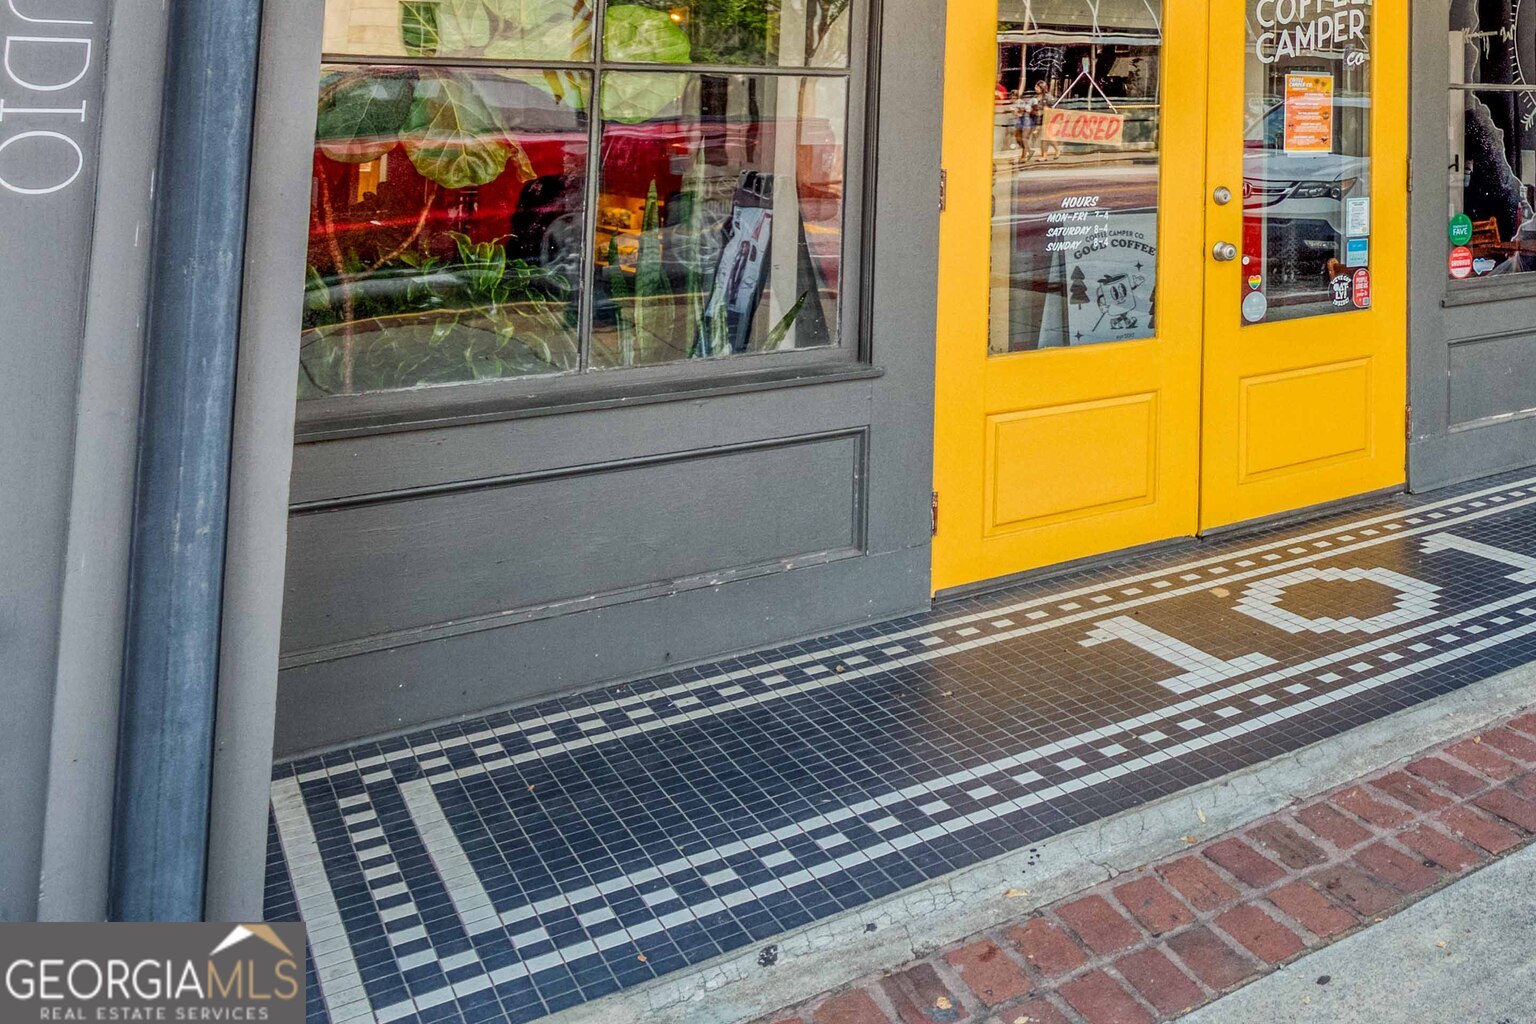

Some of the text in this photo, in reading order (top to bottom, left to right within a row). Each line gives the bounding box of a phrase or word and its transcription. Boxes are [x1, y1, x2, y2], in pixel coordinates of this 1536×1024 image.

[1256, 9, 1365, 63] CAMPER
[1048, 113, 1121, 141] CLOSED
[1061, 196, 1099, 208] HOURS
[1047, 211, 1109, 223] MON-FRI 7-4
[1046, 223, 1108, 237] SATURDAY 8-4
[1108, 230, 1134, 238] CAMPER
[1452, 227, 1468, 236] FAVE
[1046, 237, 1109, 252] SUNDAY 8-4
[1111, 239, 1157, 256] COFFEE
